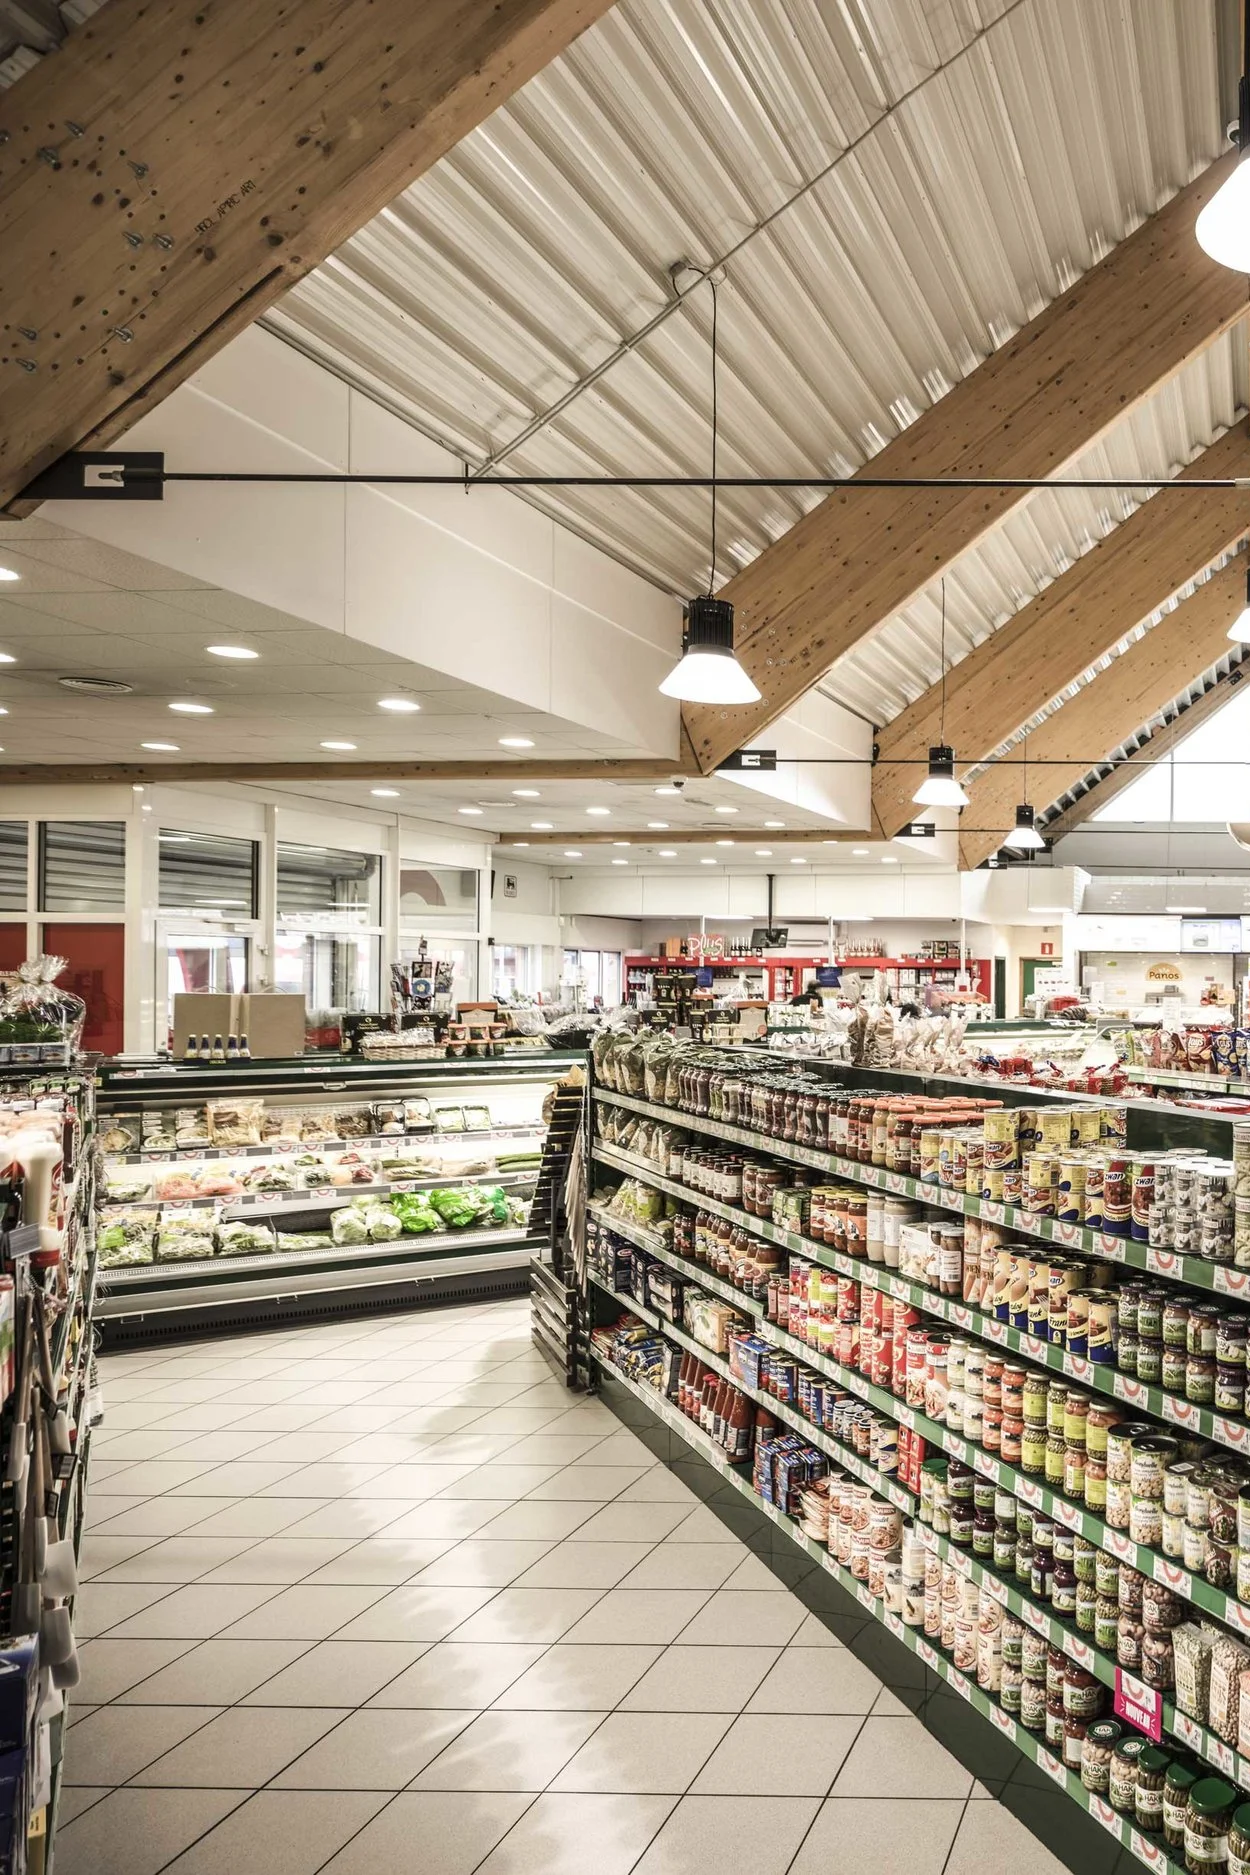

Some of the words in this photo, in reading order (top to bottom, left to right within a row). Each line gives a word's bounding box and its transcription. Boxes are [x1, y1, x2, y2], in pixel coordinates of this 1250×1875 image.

[1149, 971, 1180, 980] Panos
[1105, 1172, 1125, 1182] zwan
[1118, 1784, 1134, 1793] HAK
